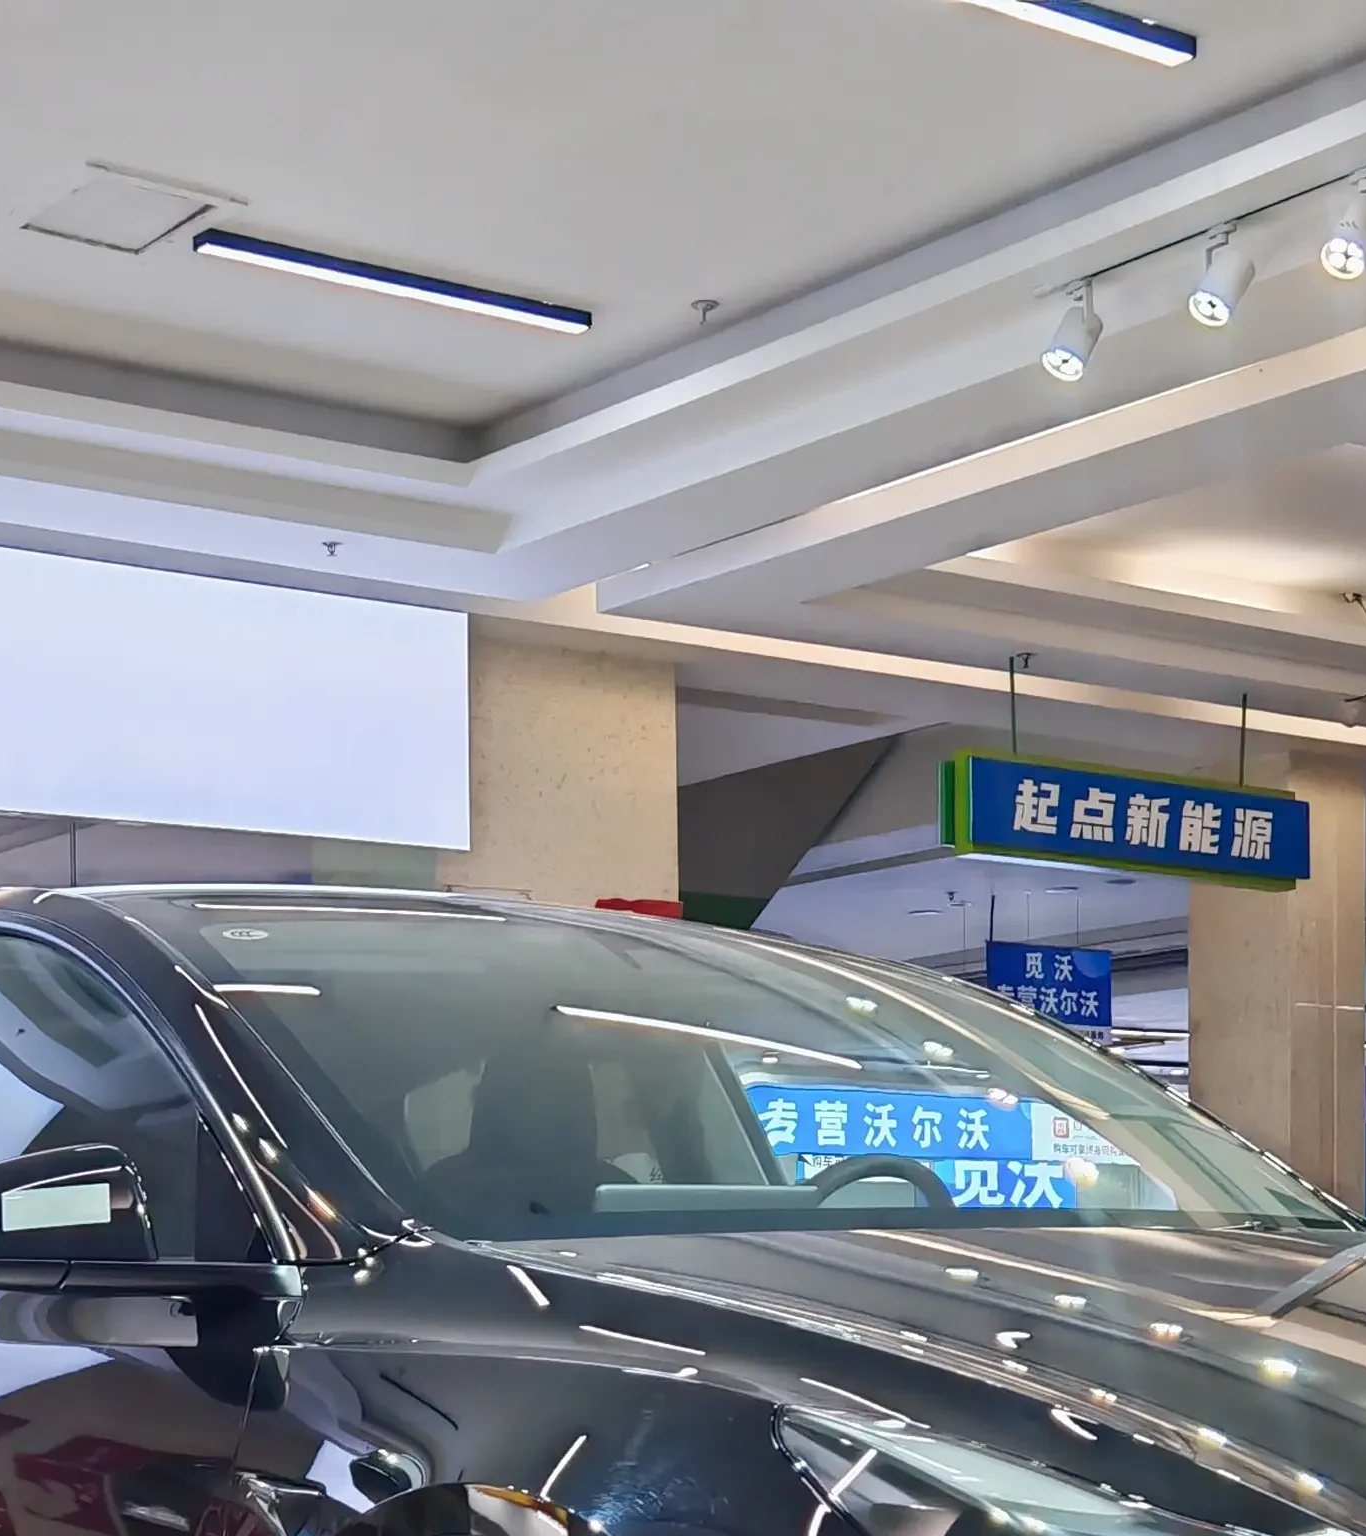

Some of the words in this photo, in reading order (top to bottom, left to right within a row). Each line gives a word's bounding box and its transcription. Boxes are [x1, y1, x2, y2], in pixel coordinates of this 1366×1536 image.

[1013, 778, 1274, 861] 起点新能源
[758, 1097, 991, 1152] 专营沃尔沃
